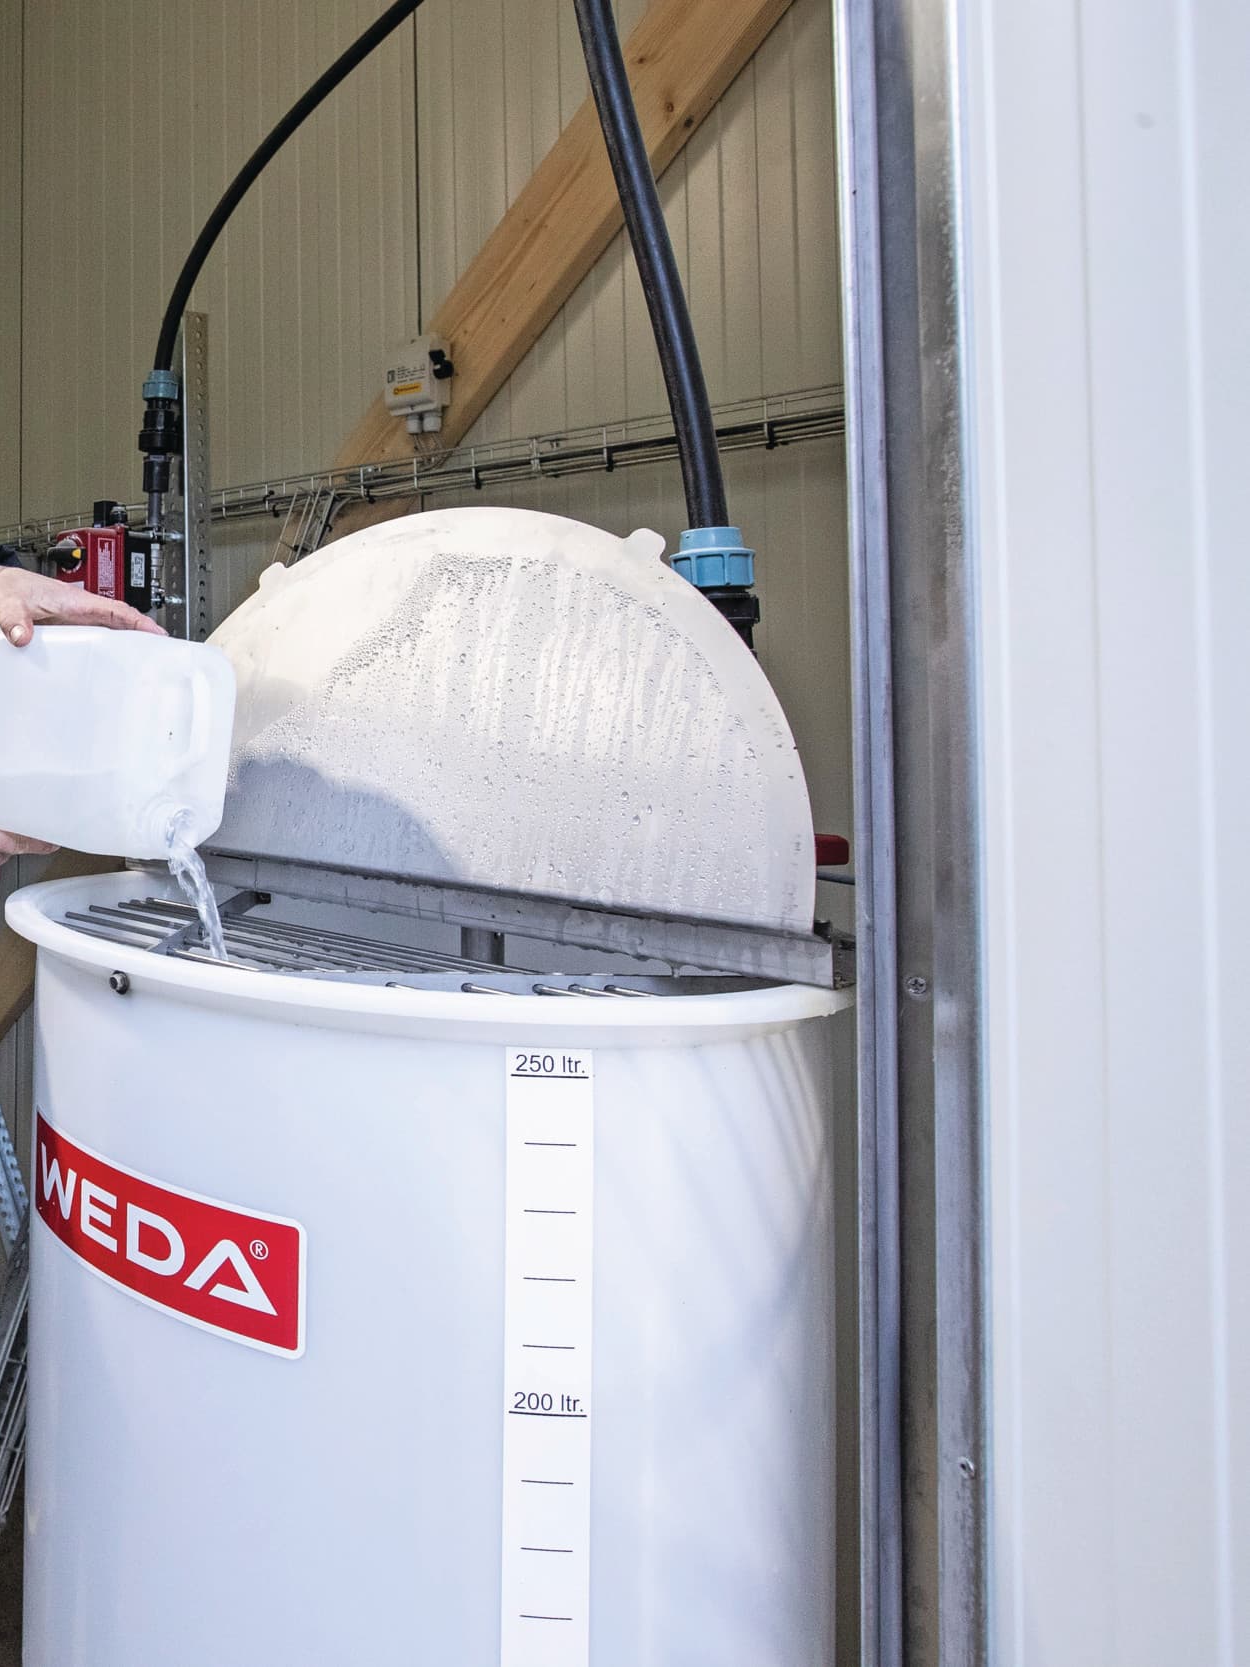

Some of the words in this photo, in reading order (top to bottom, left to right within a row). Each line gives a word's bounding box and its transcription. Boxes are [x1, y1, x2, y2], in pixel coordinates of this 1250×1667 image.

[516, 1054, 555, 1073] 250
[562, 1055, 585, 1074] ltr.
[514, 1391, 553, 1411] 200
[561, 1393, 584, 1412] ltr.
